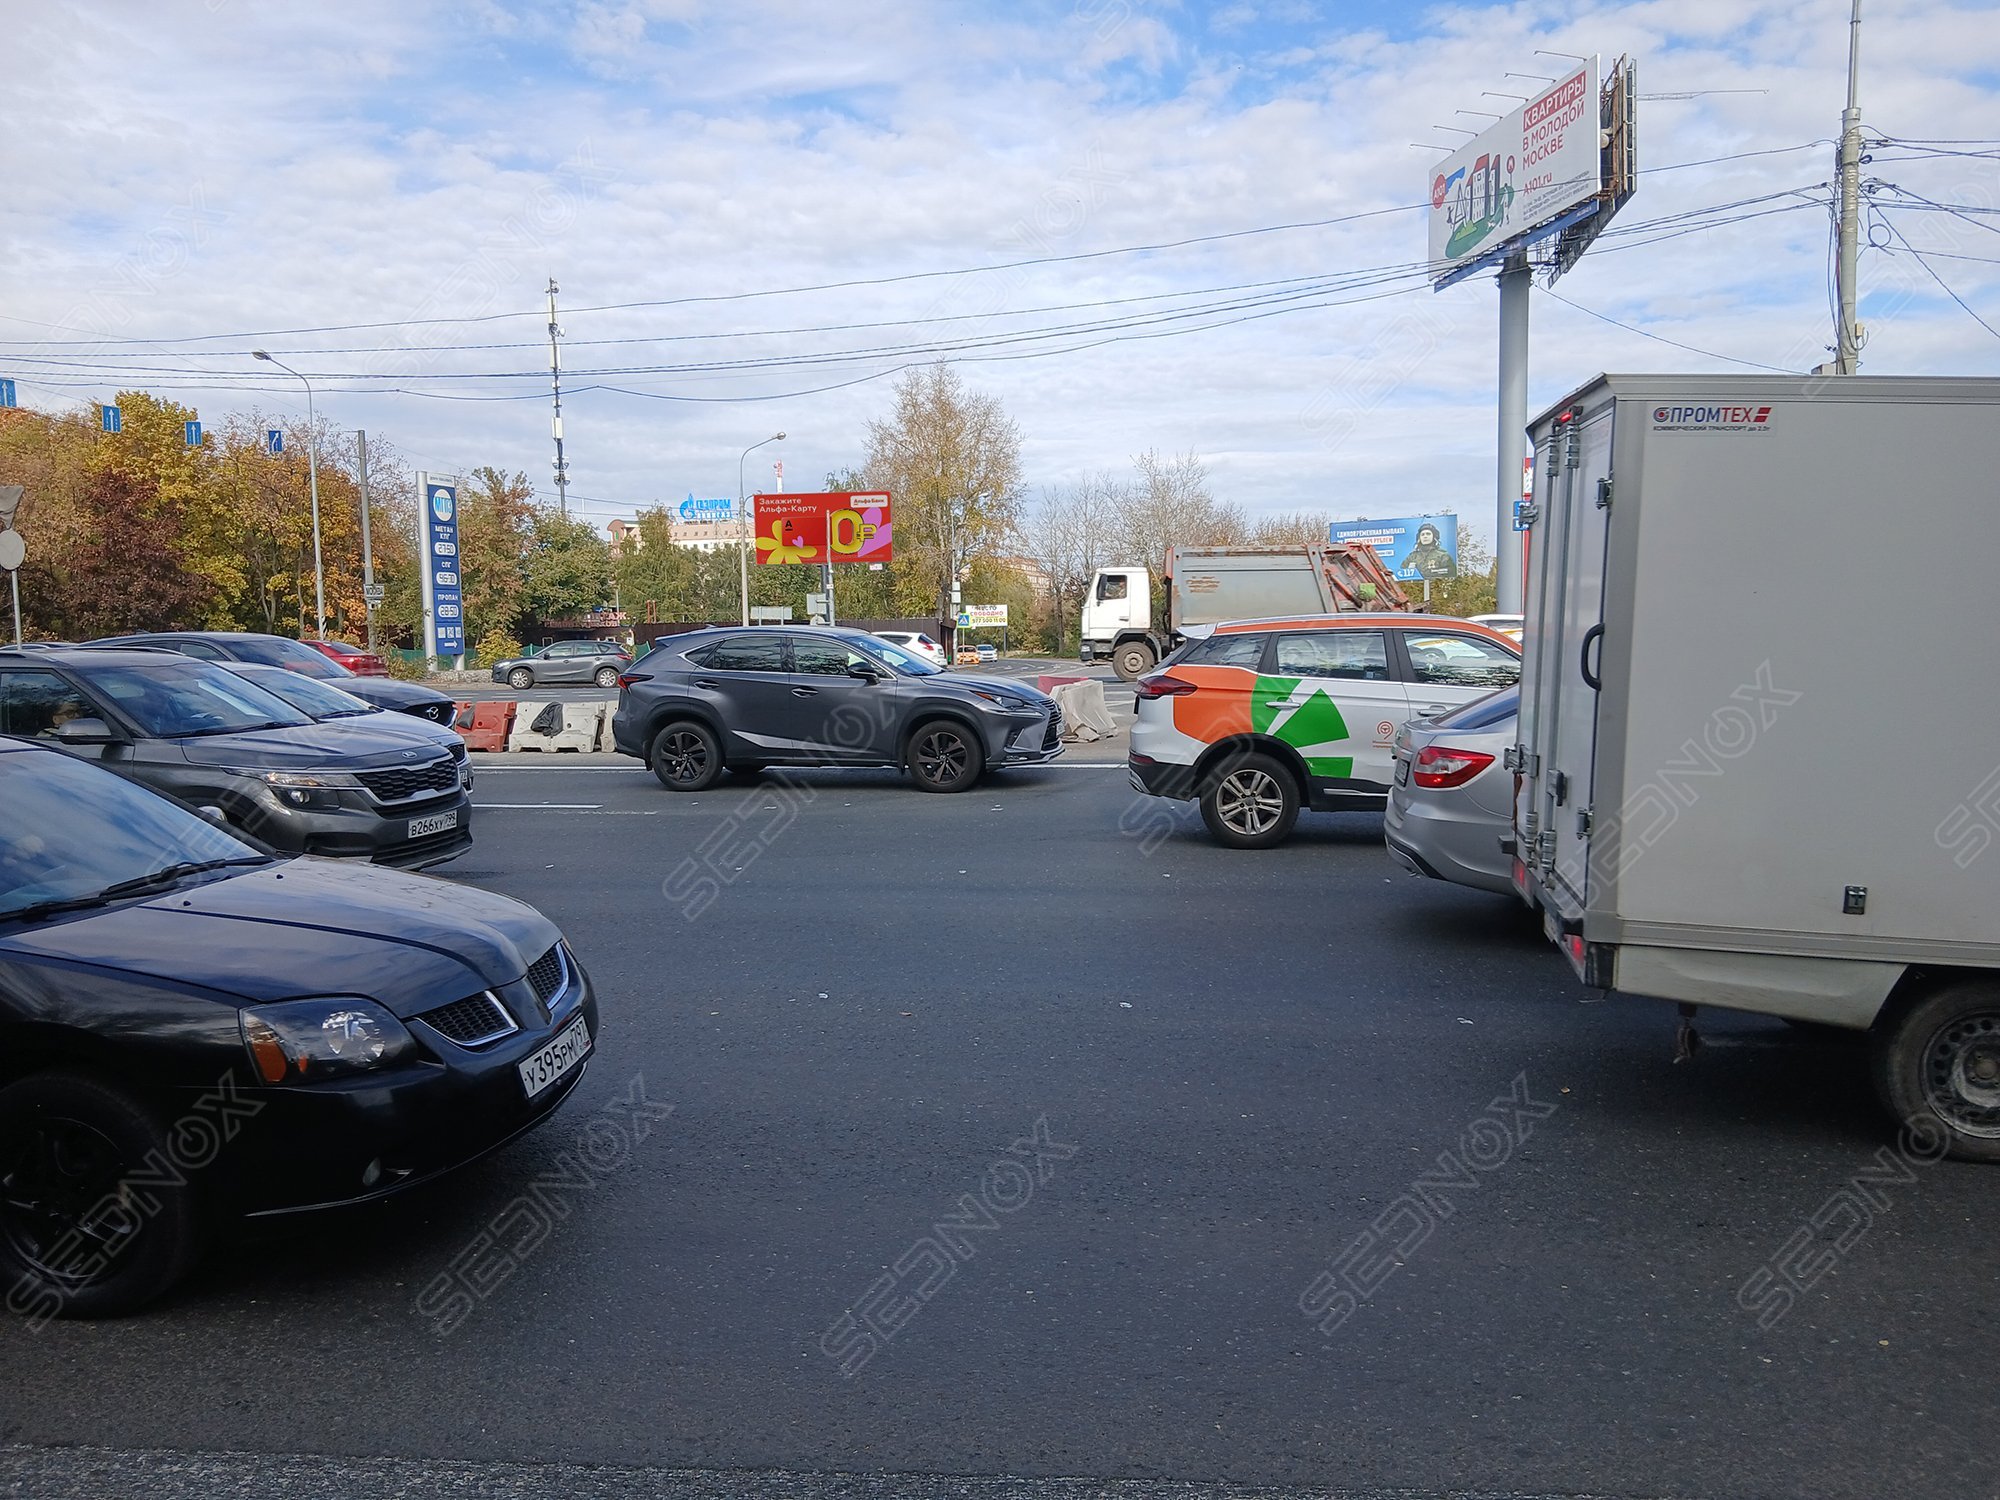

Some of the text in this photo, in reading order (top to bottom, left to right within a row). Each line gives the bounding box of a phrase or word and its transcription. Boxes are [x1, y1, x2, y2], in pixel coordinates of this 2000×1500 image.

[1524, 75, 1585, 130] КВАРТИРЫ
[1523, 97, 1585, 152] В МОЛОДОЙ
[1522, 134, 1563, 171] МОСКВЕ
[1670, 407, 1753, 423] ПРОМТЕХ
[759, 505, 817, 514] Альфа-Карту
[1403, 569, 1415, 577] 117
